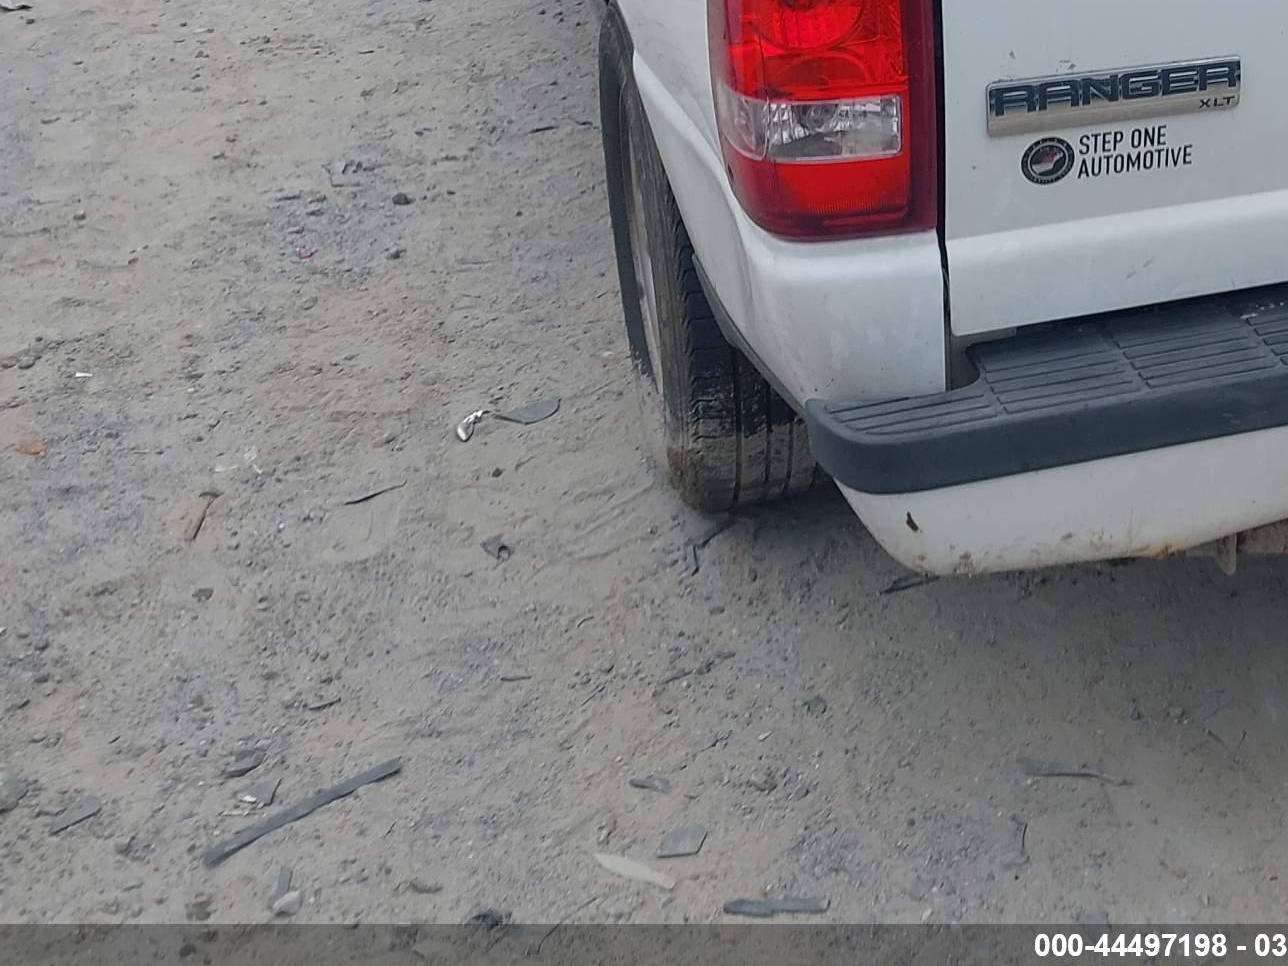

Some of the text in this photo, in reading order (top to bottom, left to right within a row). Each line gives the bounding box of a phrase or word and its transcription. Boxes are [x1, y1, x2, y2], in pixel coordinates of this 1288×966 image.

[990, 60, 1240, 117] RANGER
[1198, 95, 1237, 110] XLT
[1078, 124, 1168, 155] STEP ONE
[1078, 145, 1193, 179] AUTOMOTIVE
